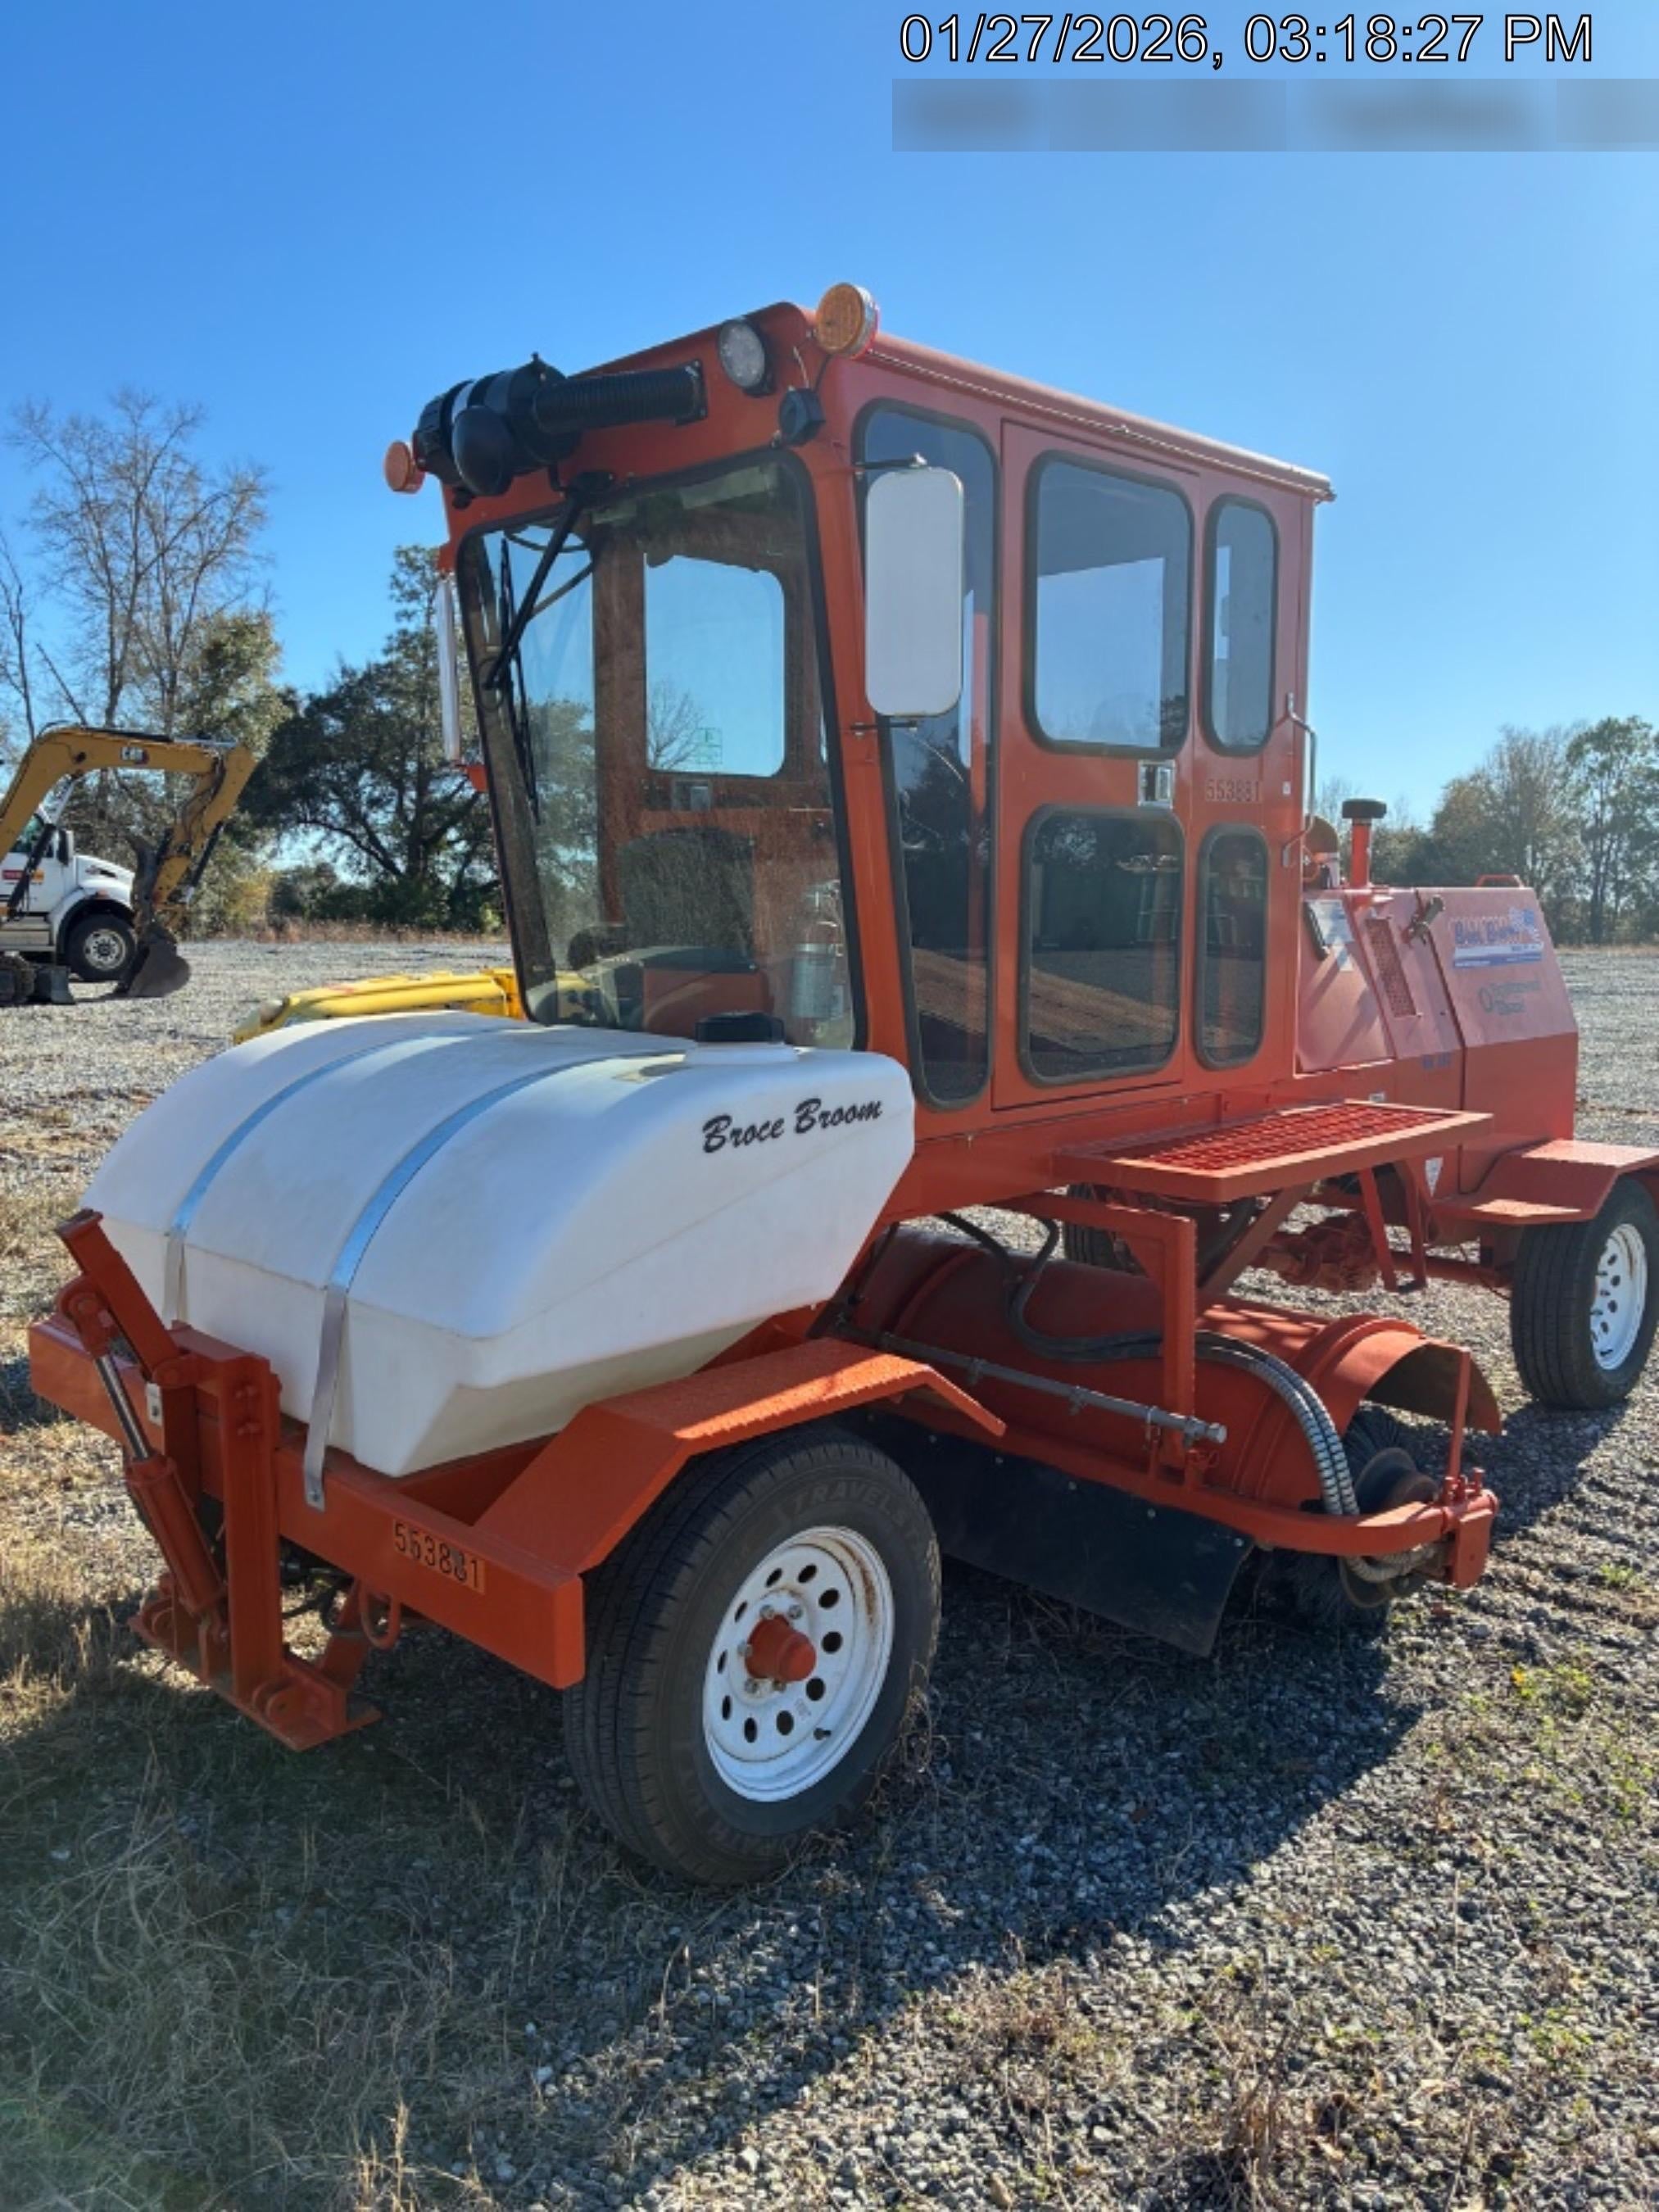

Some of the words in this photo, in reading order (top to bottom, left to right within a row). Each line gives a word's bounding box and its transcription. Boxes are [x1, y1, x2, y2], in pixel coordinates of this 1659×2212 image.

[702, 1113, 786, 1154] Broce
[794, 1097, 884, 1135] Broom
[394, 1522, 478, 1589] 553881
